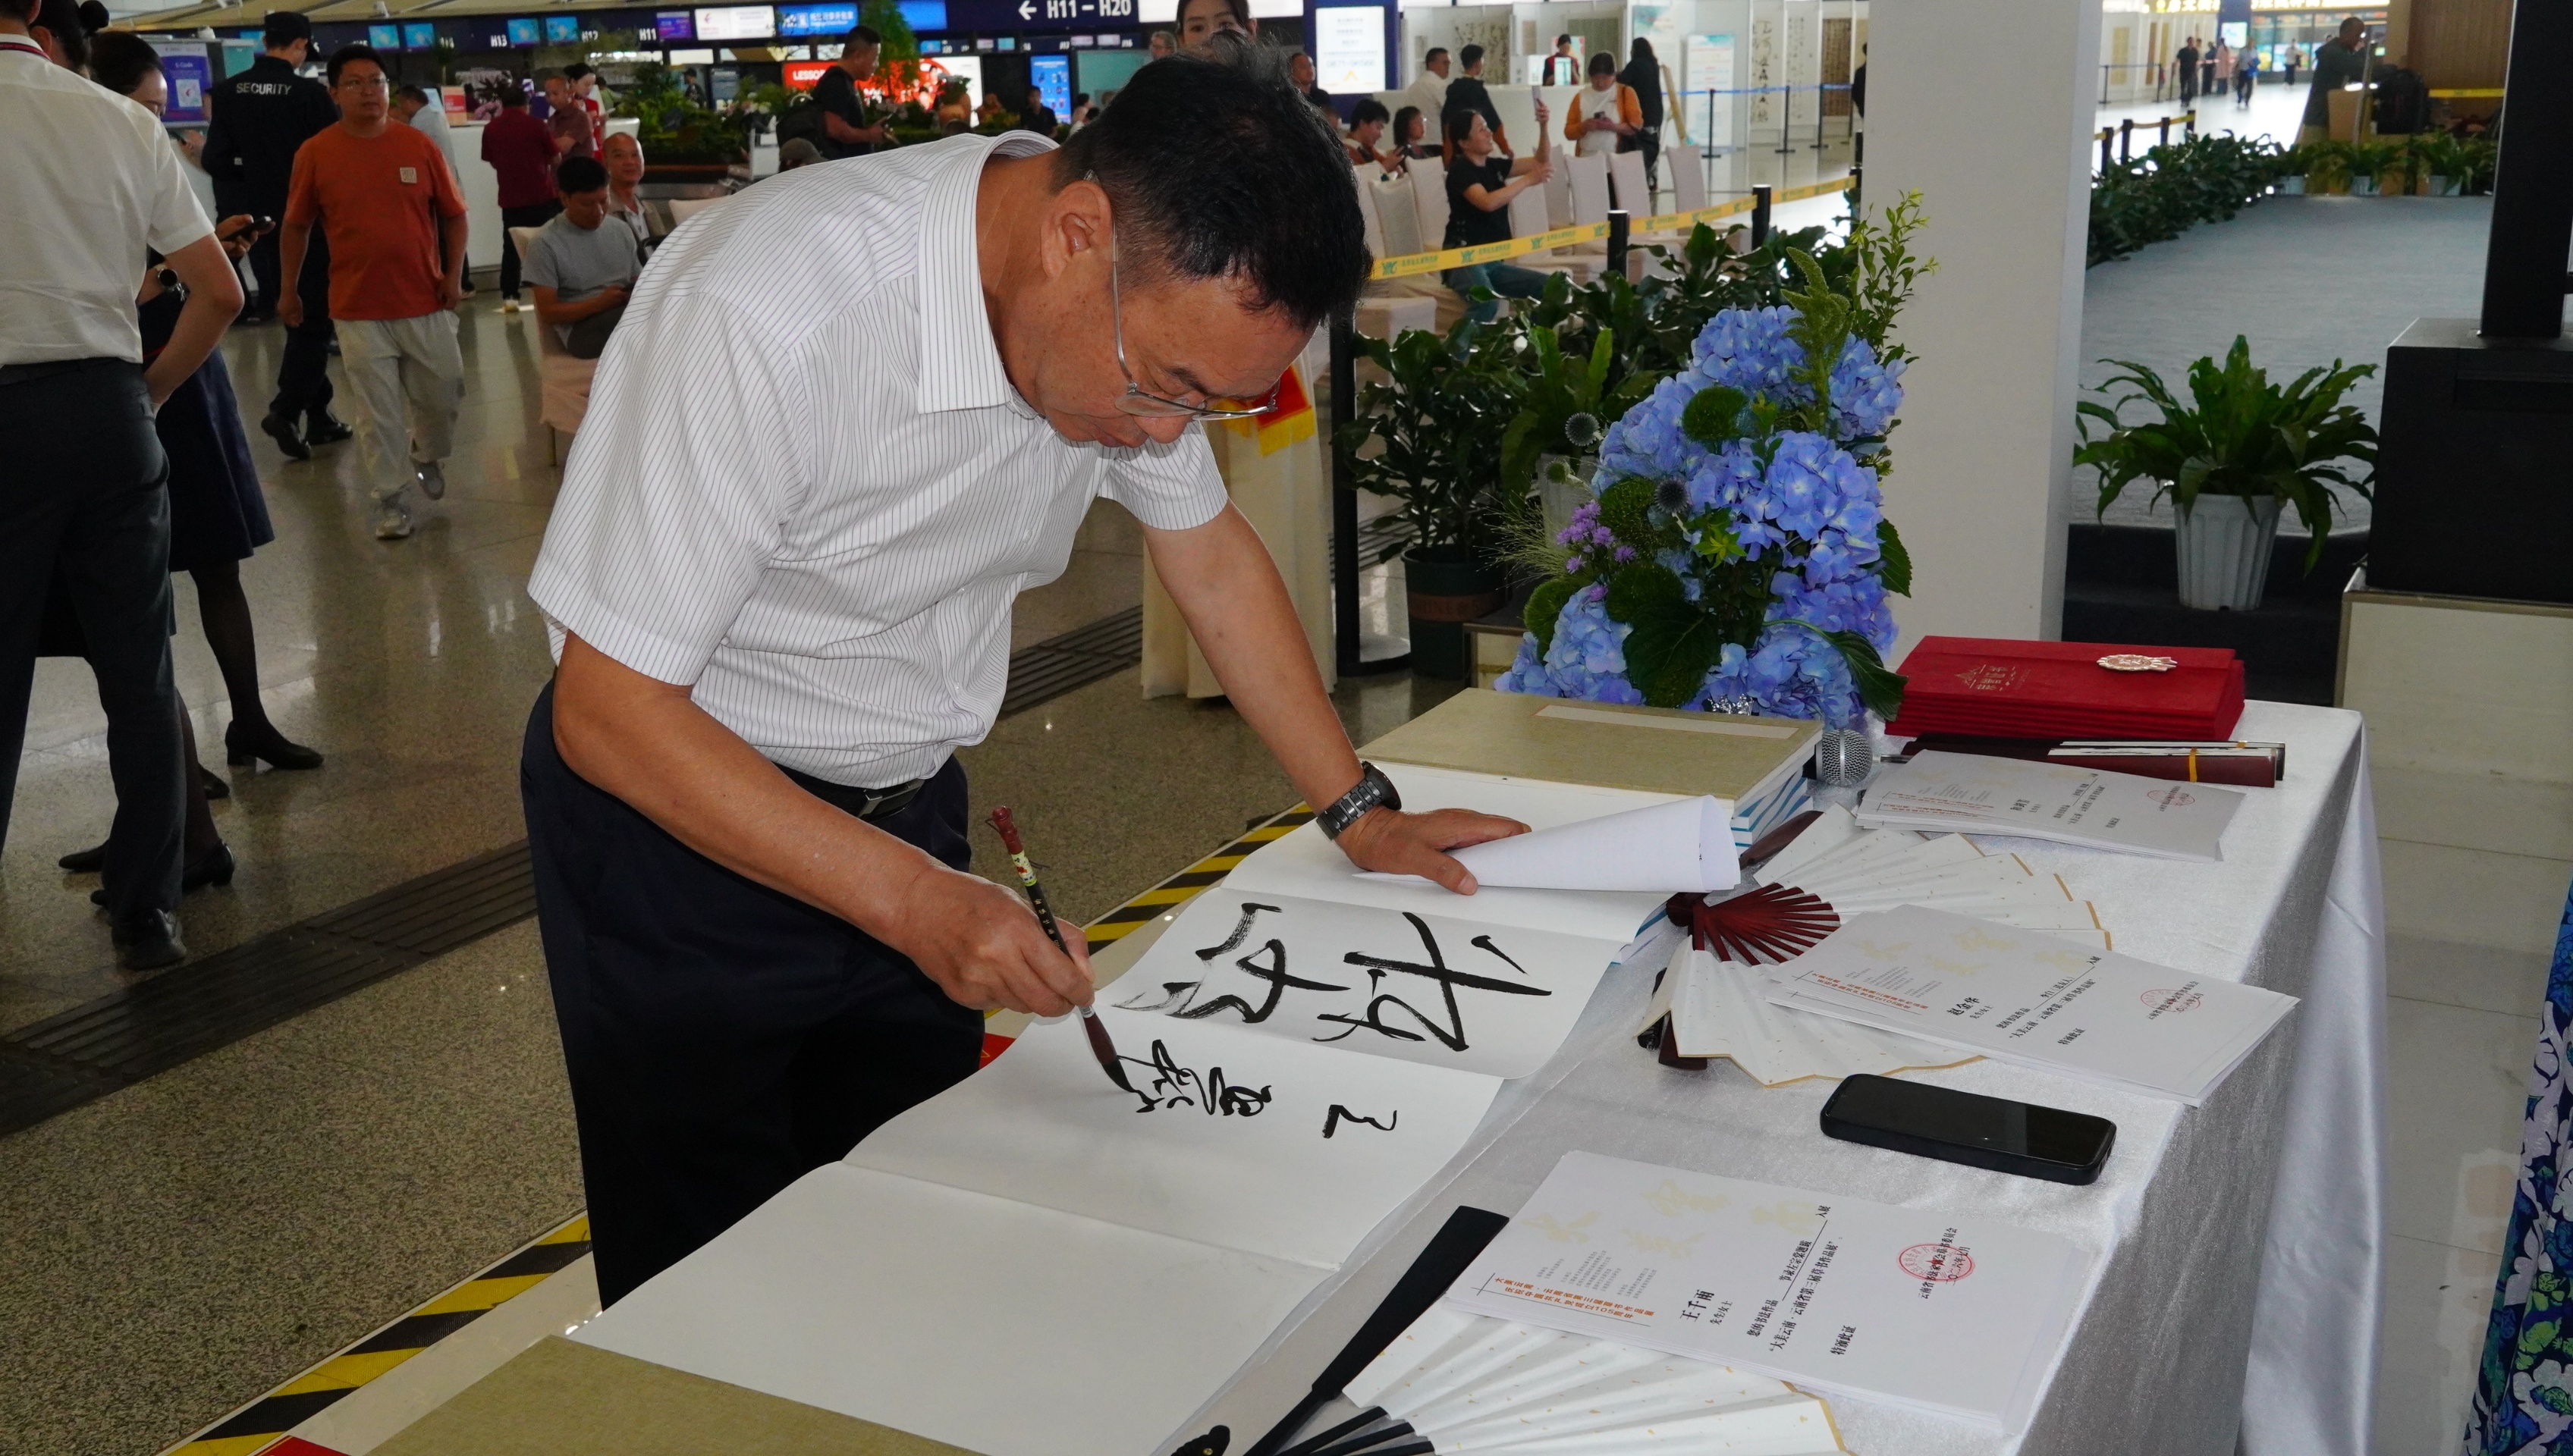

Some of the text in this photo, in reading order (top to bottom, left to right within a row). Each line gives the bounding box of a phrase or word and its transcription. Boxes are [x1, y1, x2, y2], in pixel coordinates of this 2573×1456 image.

[1047, 1, 1076, 18] H11
[1100, 0, 1132, 16] H20
[490, 35, 507, 47] H13
[236, 82, 292, 95] SECURITY
[1746, 1300, 1779, 1337] 您的书法作品
[1815, 1206, 1831, 1220] 入展
[1680, 1289, 1714, 1322] 王千雨
[1830, 1325, 1856, 1355] 特颁此证
